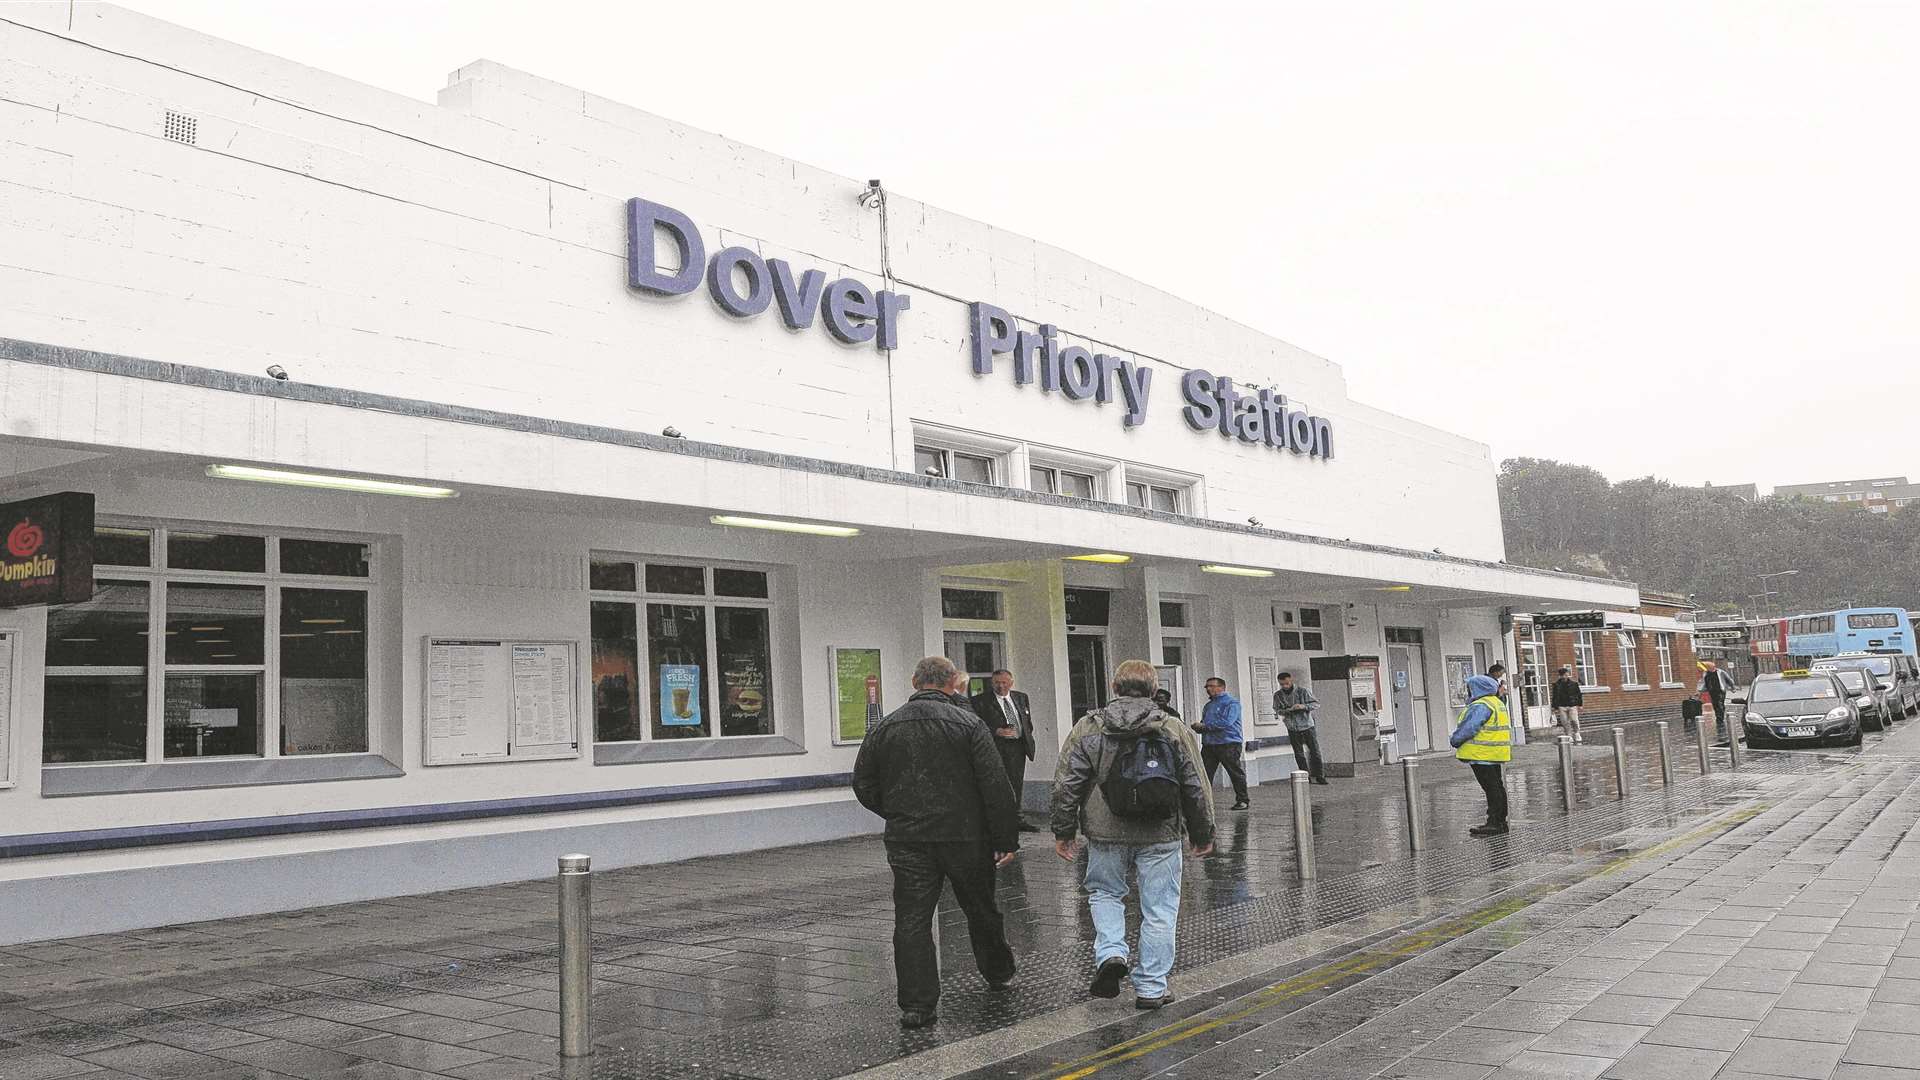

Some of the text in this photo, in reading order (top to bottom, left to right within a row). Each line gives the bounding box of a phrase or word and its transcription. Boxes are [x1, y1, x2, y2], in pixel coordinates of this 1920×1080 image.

[627, 196, 1334, 460] Dover Priory Station
